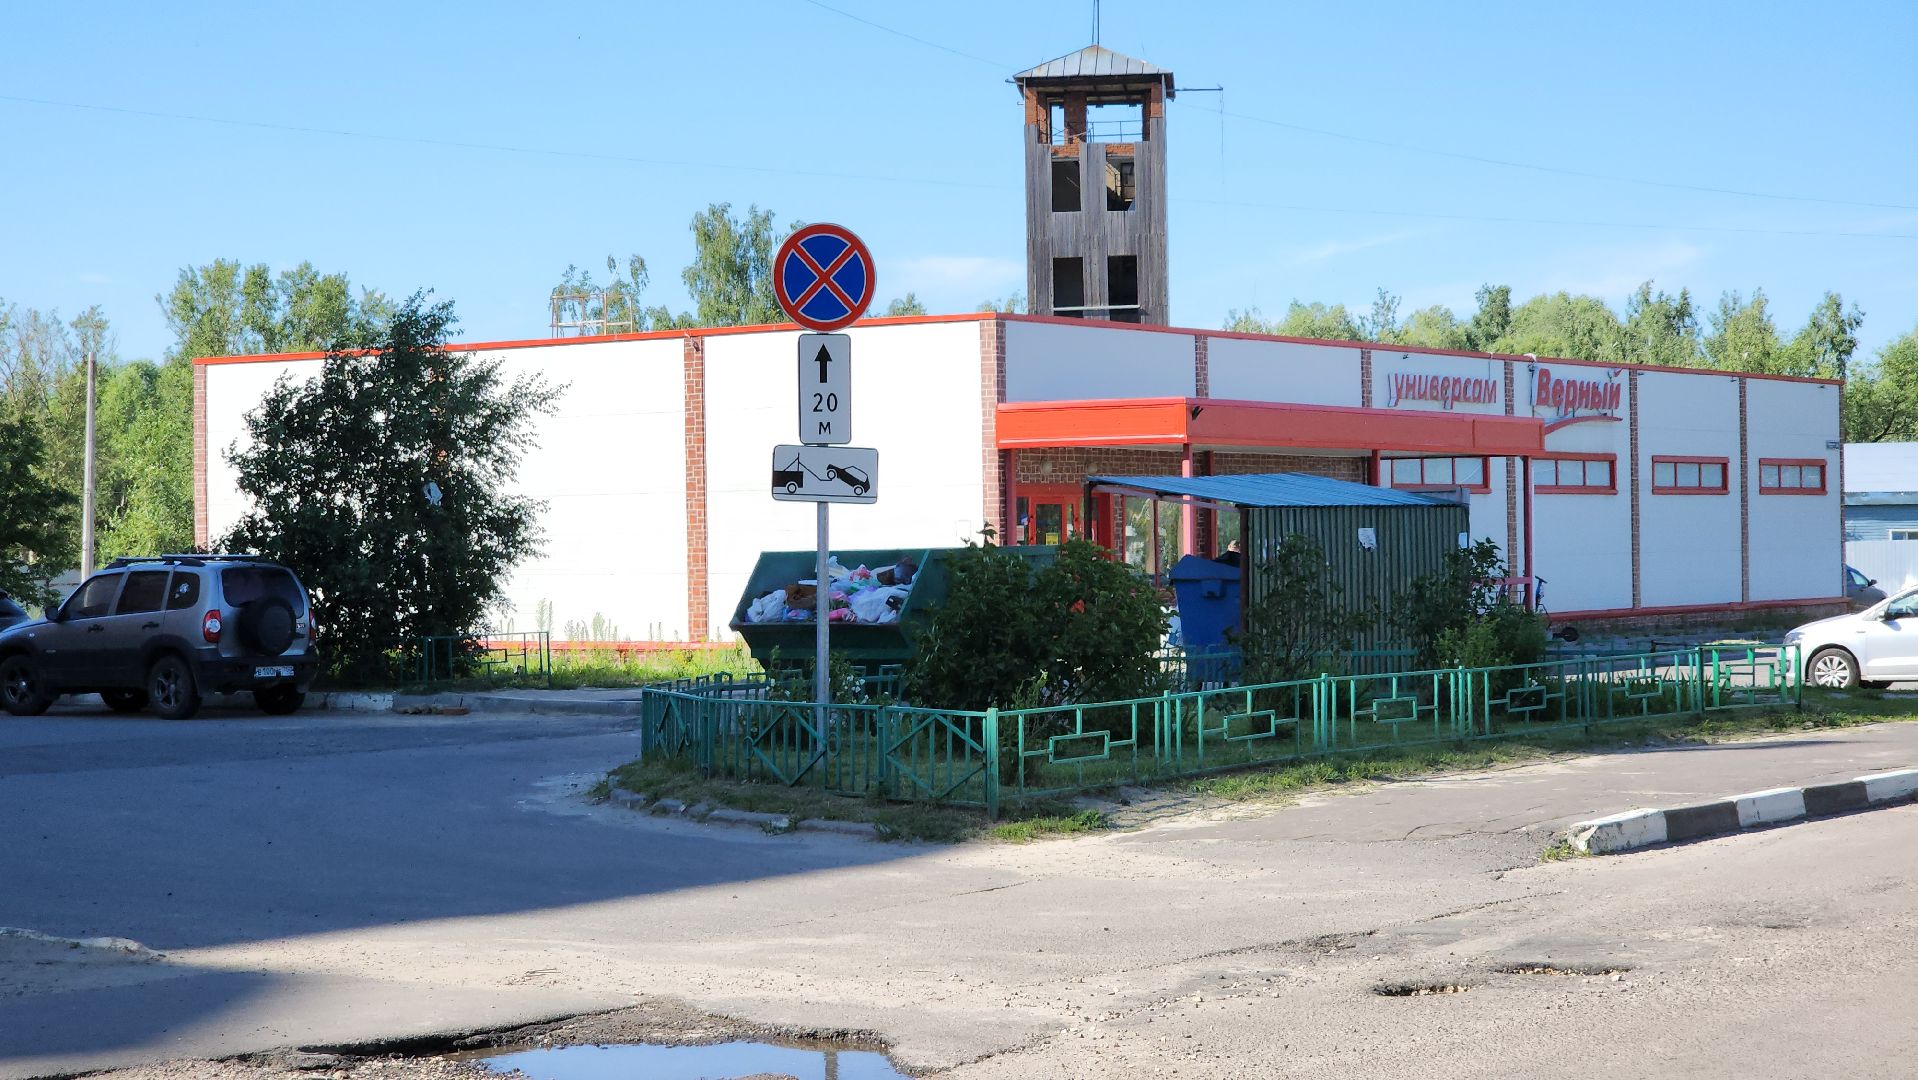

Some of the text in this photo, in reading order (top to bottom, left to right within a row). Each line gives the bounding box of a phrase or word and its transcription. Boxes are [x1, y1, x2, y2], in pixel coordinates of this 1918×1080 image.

[813, 392, 838, 412] 20
[1394, 368, 1622, 415] универсам Верный
